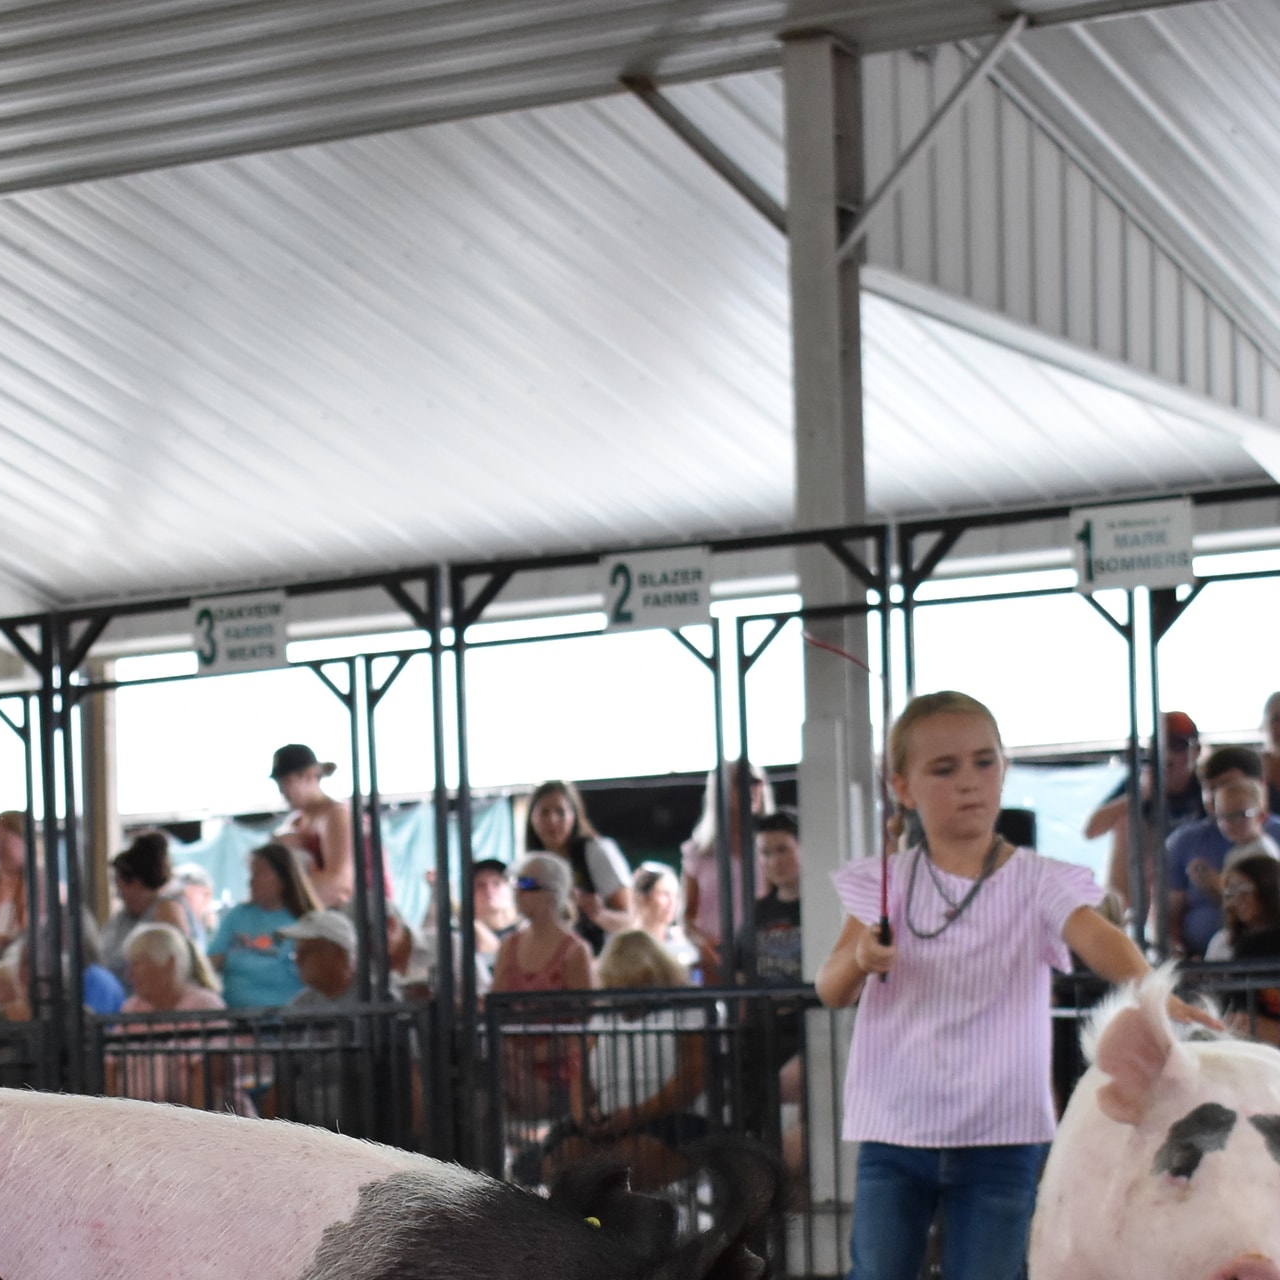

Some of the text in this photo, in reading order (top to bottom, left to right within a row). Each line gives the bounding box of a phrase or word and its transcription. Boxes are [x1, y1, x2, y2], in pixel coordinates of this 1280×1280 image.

[1076, 518, 1094, 582] 1
[1114, 530, 1167, 550] MARK
[1094, 549, 1189, 574] SOMMERS
[638, 567, 704, 590] BLAZER
[610, 562, 633, 623] 2
[642, 589, 699, 609] FARMS
[196, 608, 216, 667] 3
[226, 642, 276, 661] MEATS
